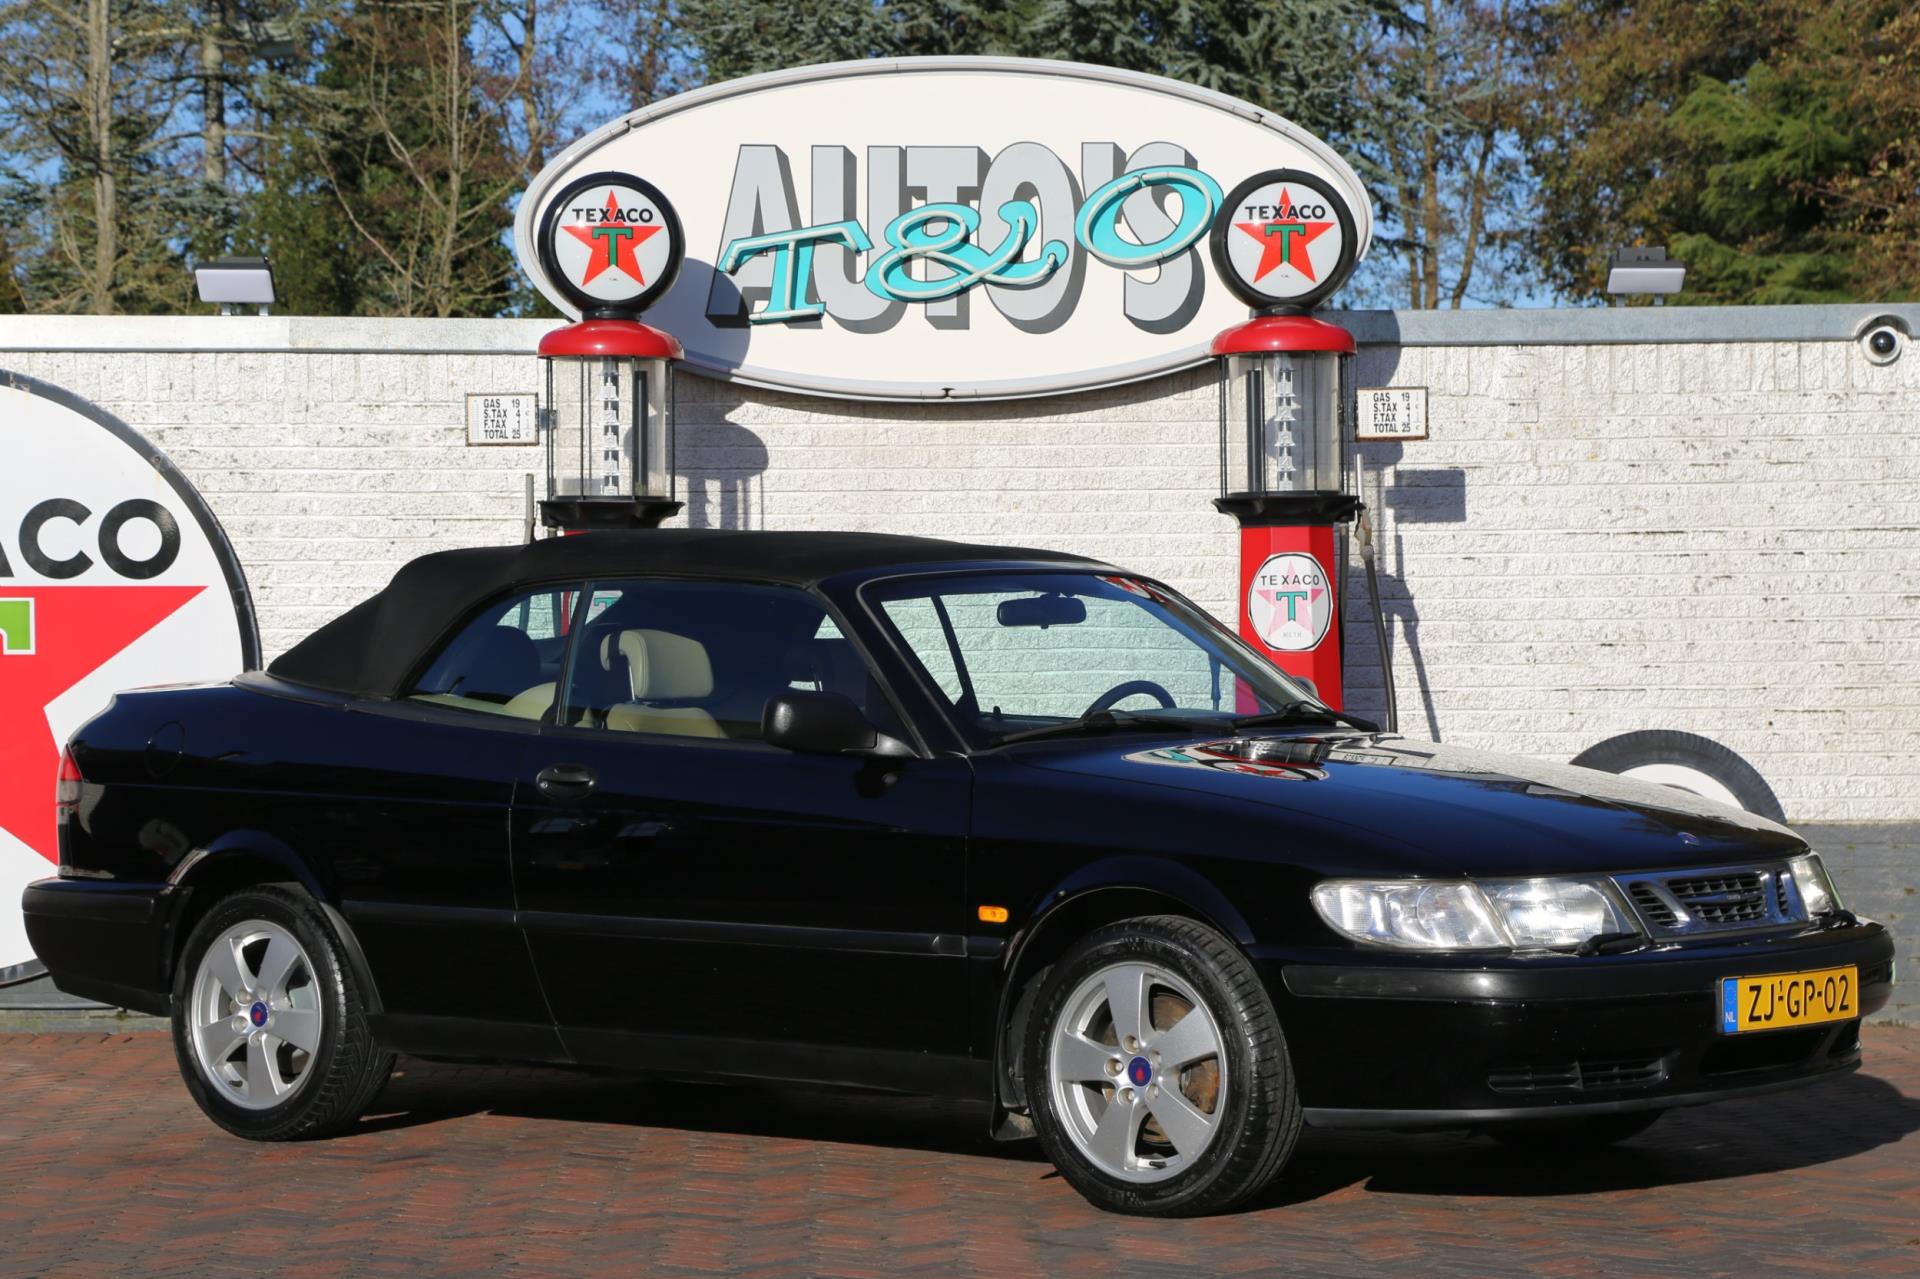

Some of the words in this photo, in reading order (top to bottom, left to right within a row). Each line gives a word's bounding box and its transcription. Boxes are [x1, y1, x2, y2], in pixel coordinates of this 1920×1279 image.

[572, 208, 653, 223] TEXACO
[1245, 204, 1325, 220] TEXACO
[1373, 392, 1391, 402] GAS
[1401, 392, 1410, 402] 19
[483, 398, 501, 408] GAS
[511, 398, 521, 408] 19
[1373, 403, 1398, 412] S.TAX
[483, 409, 508, 418] S.TAX
[1373, 413, 1397, 422] F.TAX
[483, 419, 507, 428] F.TAX
[1373, 423, 1398, 433] TOTAL
[1401, 423, 1411, 433] 25
[484, 429, 509, 439] TOTAL
[511, 429, 521, 439] 25
[1261, 574, 1320, 586] TEXACO
[1725, 1011, 1736, 1023] NL
[1748, 974, 1849, 1023] ZJ-GP-02
